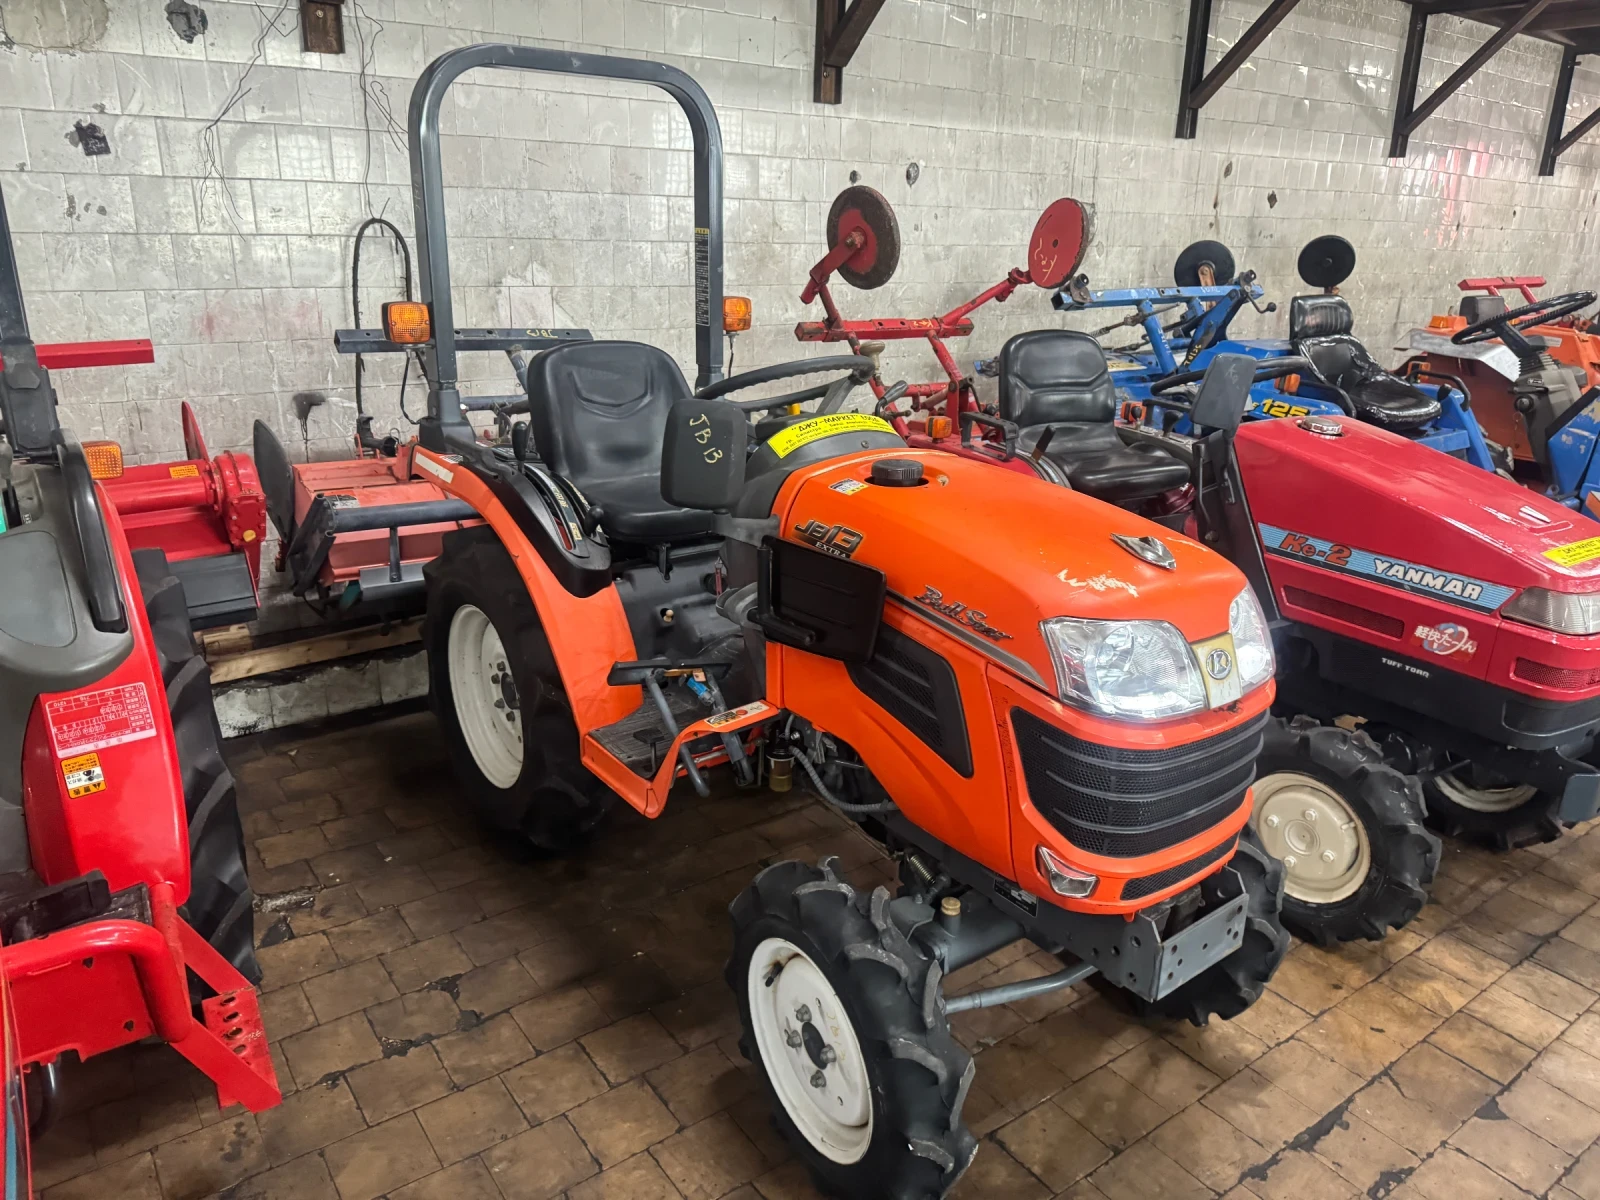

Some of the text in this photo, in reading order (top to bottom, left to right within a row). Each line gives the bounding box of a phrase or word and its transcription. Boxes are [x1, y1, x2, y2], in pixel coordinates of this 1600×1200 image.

[689, 413, 723, 464] JB13
[795, 519, 864, 553] JB13
[815, 541, 847, 558] EXTRA
[1278, 532, 1483, 601] Ke-2 YANMAR
[1381, 657, 1430, 678] TUFF TORQ
